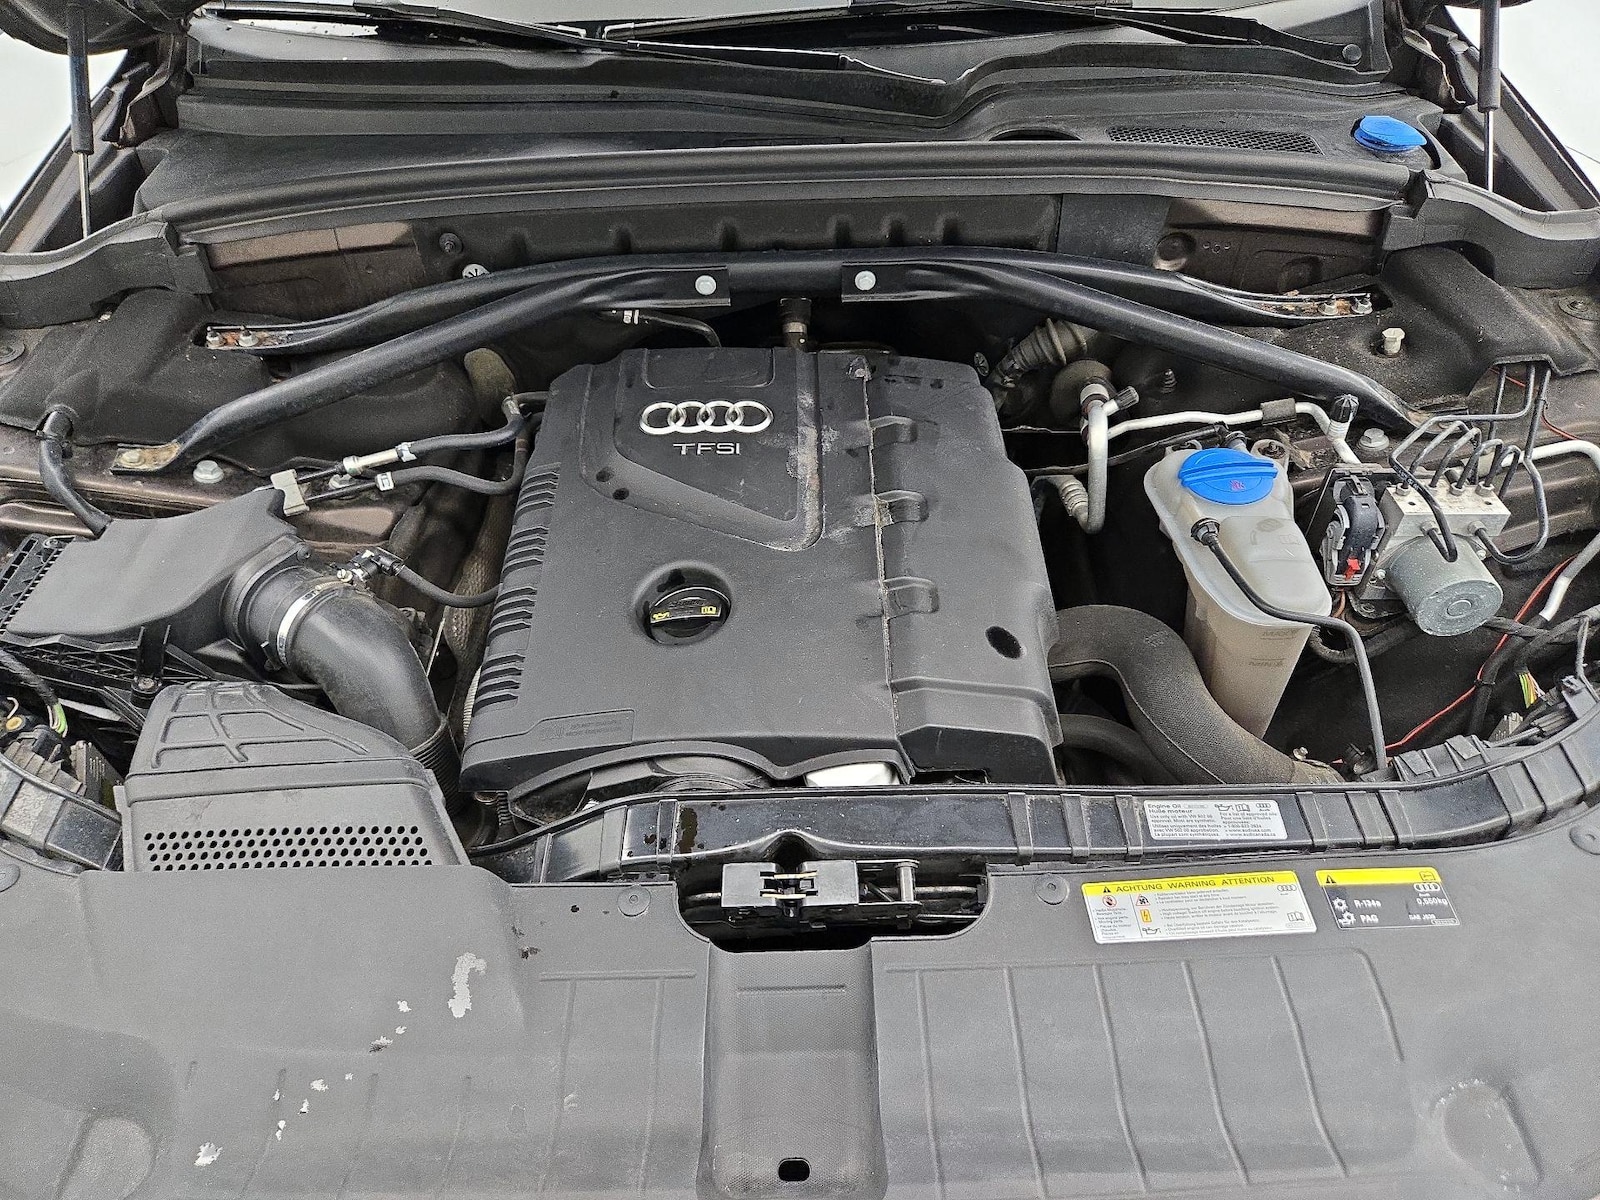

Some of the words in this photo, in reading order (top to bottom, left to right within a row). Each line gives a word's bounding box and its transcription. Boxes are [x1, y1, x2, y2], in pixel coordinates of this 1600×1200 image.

[672, 442, 740, 455] TFSI
[1116, 884, 1163, 892] ACHTUNG
[1168, 880, 1216, 888] WARNING
[1221, 876, 1275, 886] ATTENTION
[1354, 899, 1382, 908] R-134a
[1360, 914, 1379, 923] PAG
